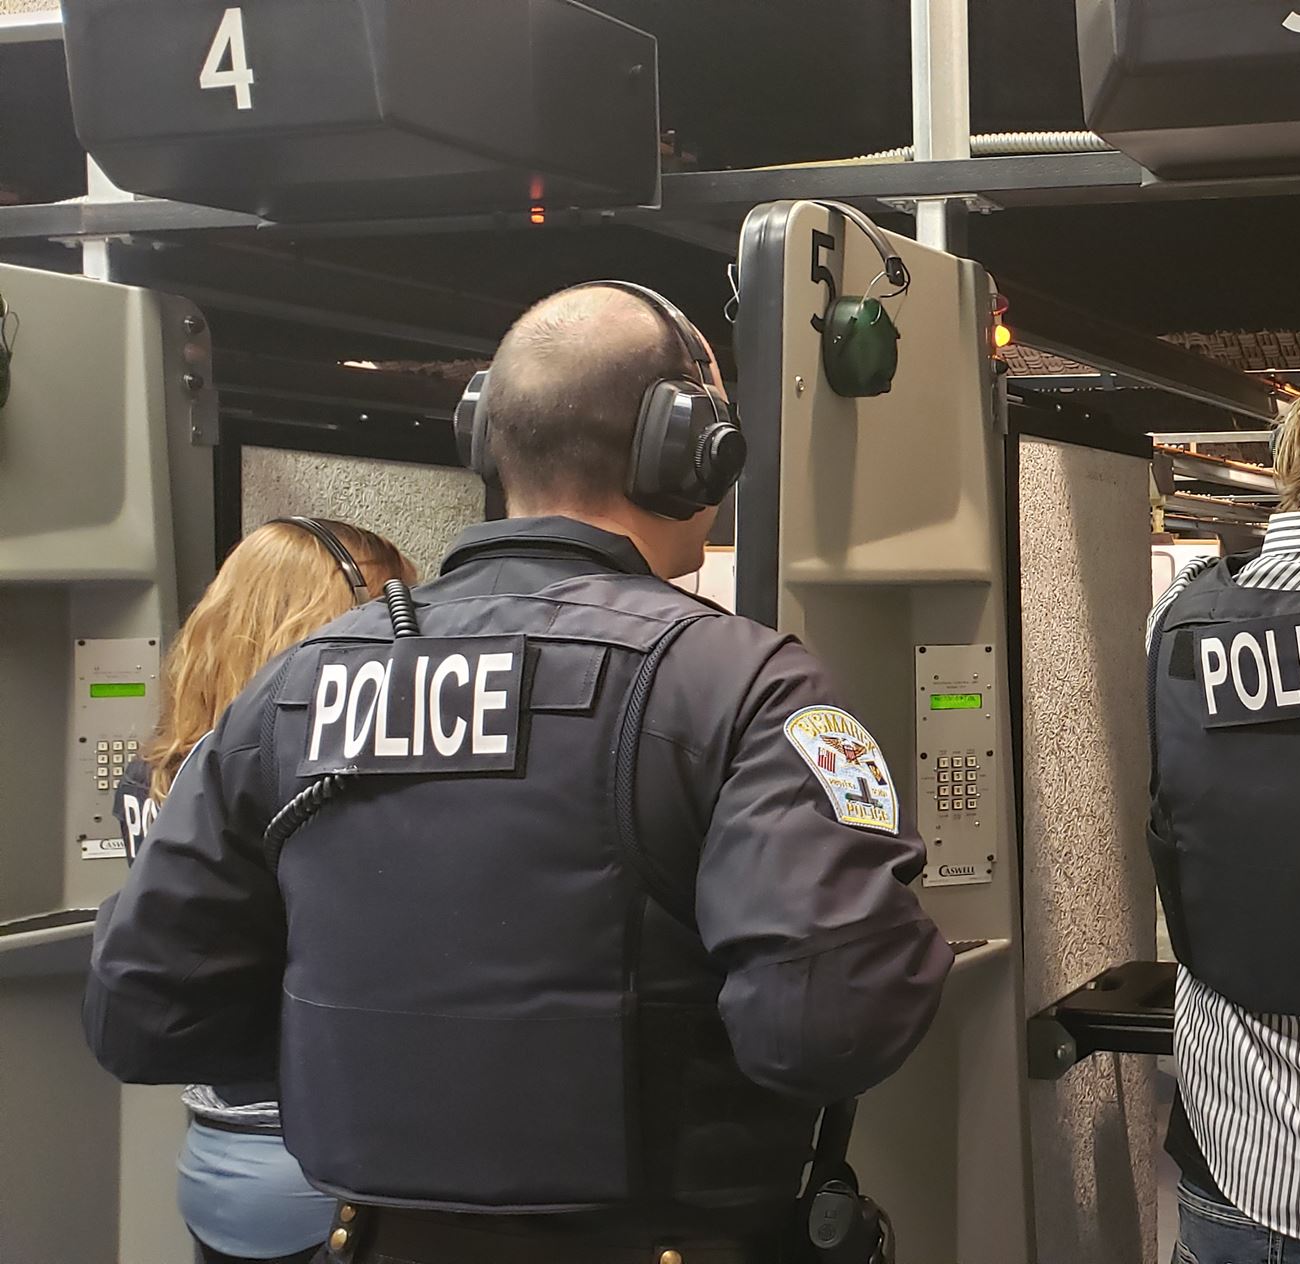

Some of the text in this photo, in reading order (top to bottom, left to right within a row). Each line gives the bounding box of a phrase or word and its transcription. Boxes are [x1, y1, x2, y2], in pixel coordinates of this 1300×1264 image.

[200, 7, 254, 110] 4
[811, 228, 836, 334] 5
[309, 652, 513, 761] POLICE
[846, 802, 888, 821] POLICE
[939, 864, 974, 877] CASWELL
